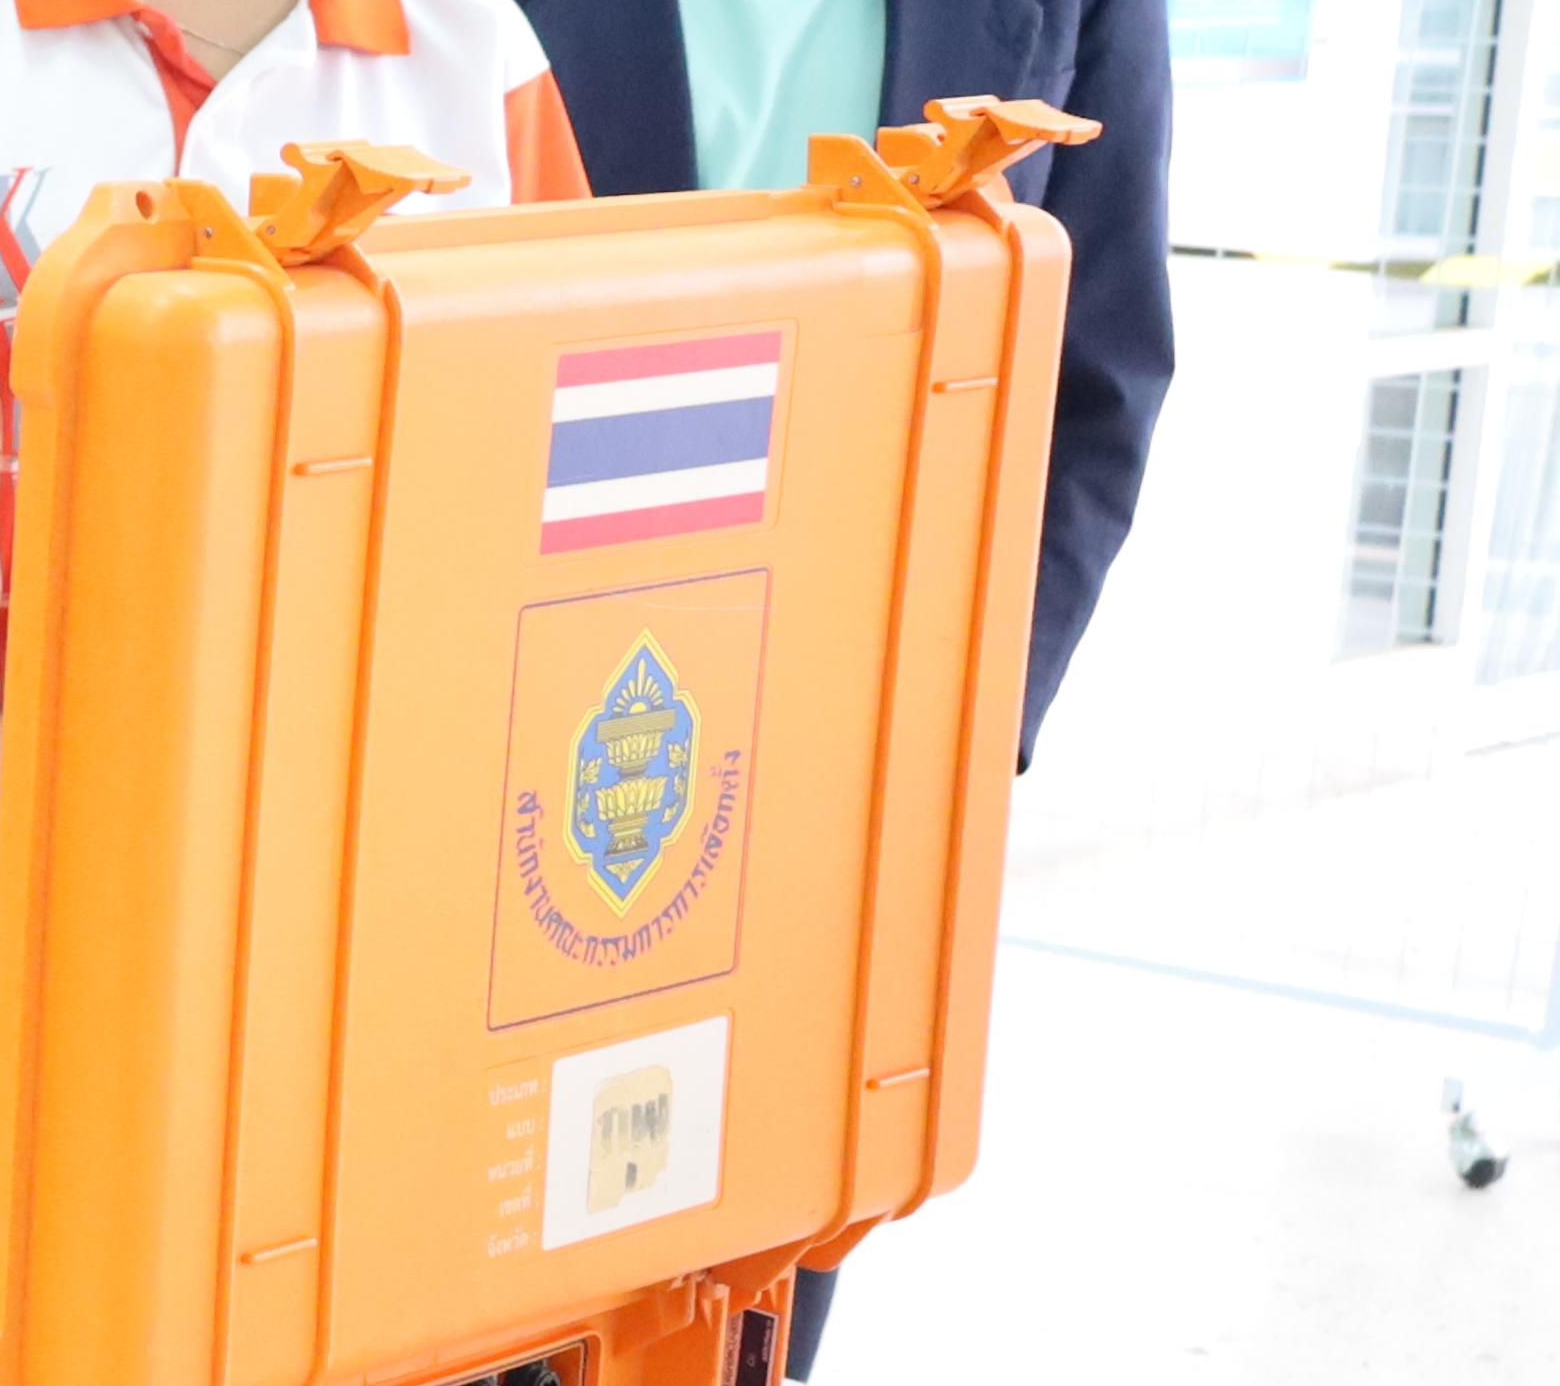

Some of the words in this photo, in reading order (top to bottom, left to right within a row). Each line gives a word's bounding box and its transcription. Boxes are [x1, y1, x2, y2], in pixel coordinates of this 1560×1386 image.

[515, 750, 741, 966] สำนักงานคณะกรรมการการเลือกตั้ง
